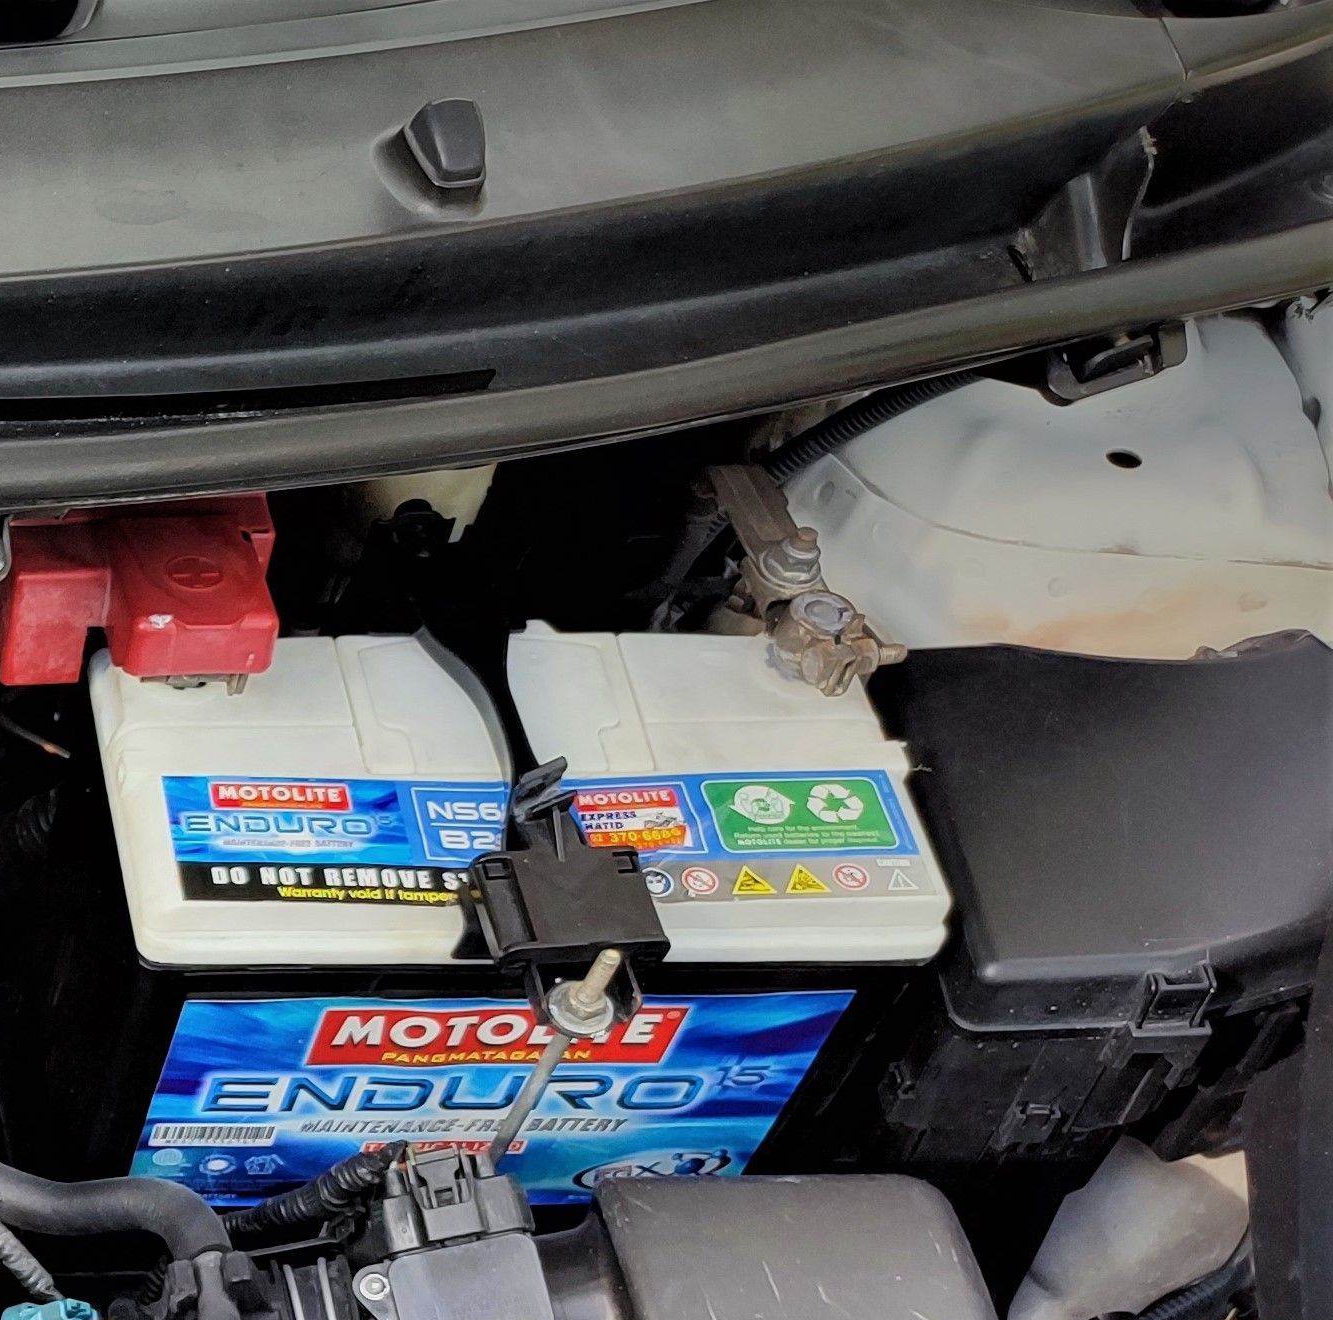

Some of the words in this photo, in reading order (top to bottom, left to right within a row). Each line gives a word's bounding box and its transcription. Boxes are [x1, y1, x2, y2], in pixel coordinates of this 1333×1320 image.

[218, 784, 343, 804] MOTOLITE
[577, 789, 672, 807] MOTOLITE
[426, 801, 506, 821] NS6
[581, 811, 637, 821] EXPRESS
[185, 814, 374, 836] ENDURO
[211, 866, 249, 885] DO
[260, 866, 314, 886] NOT
[324, 867, 432, 889] REMOVE
[278, 886, 345, 901] Warranty
[348, 888, 380, 900] void
[384, 888, 395, 900] if
[331, 1012, 669, 1047] MOTOLE
[381, 1049, 592, 1064] PANGMATAGAAN
[201, 1074, 705, 1113] ENDURO
[300, 1117, 506, 1134] MAINTENANCE-FRE
[524, 1116, 630, 1134] BATTERY
